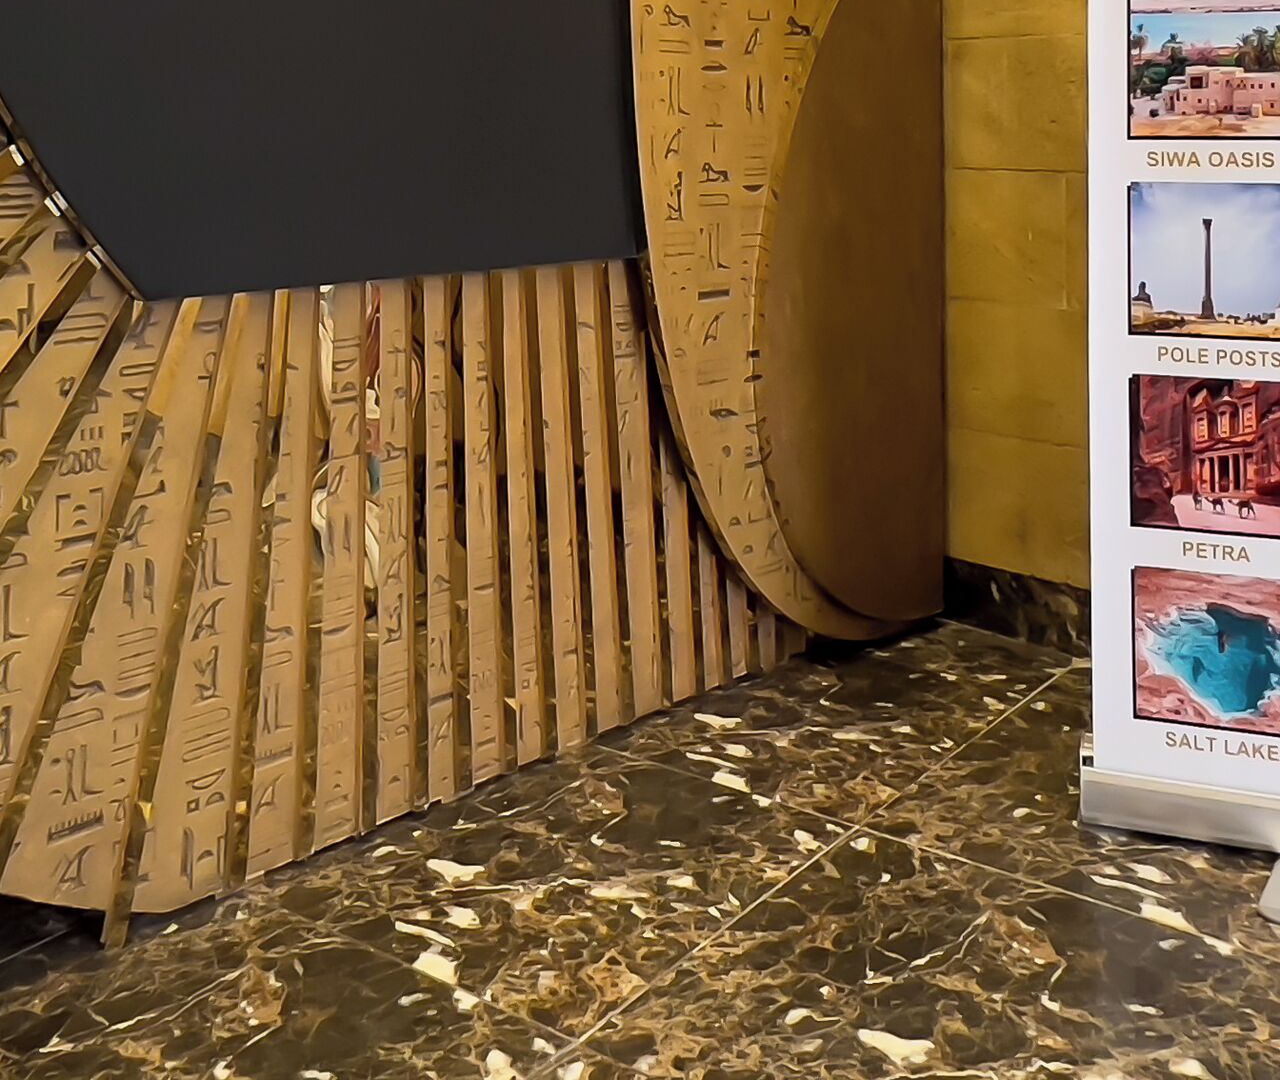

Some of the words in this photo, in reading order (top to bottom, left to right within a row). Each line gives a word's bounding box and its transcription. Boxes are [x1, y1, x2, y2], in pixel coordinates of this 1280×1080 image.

[1146, 151, 1201, 168] SIWA
[1208, 151, 1275, 168] OASIS
[1157, 346, 1209, 365] POLE
[1182, 541, 1251, 563] PETRA
[1164, 731, 1219, 756] SALT
[1224, 739, 1280, 763] LAKE
